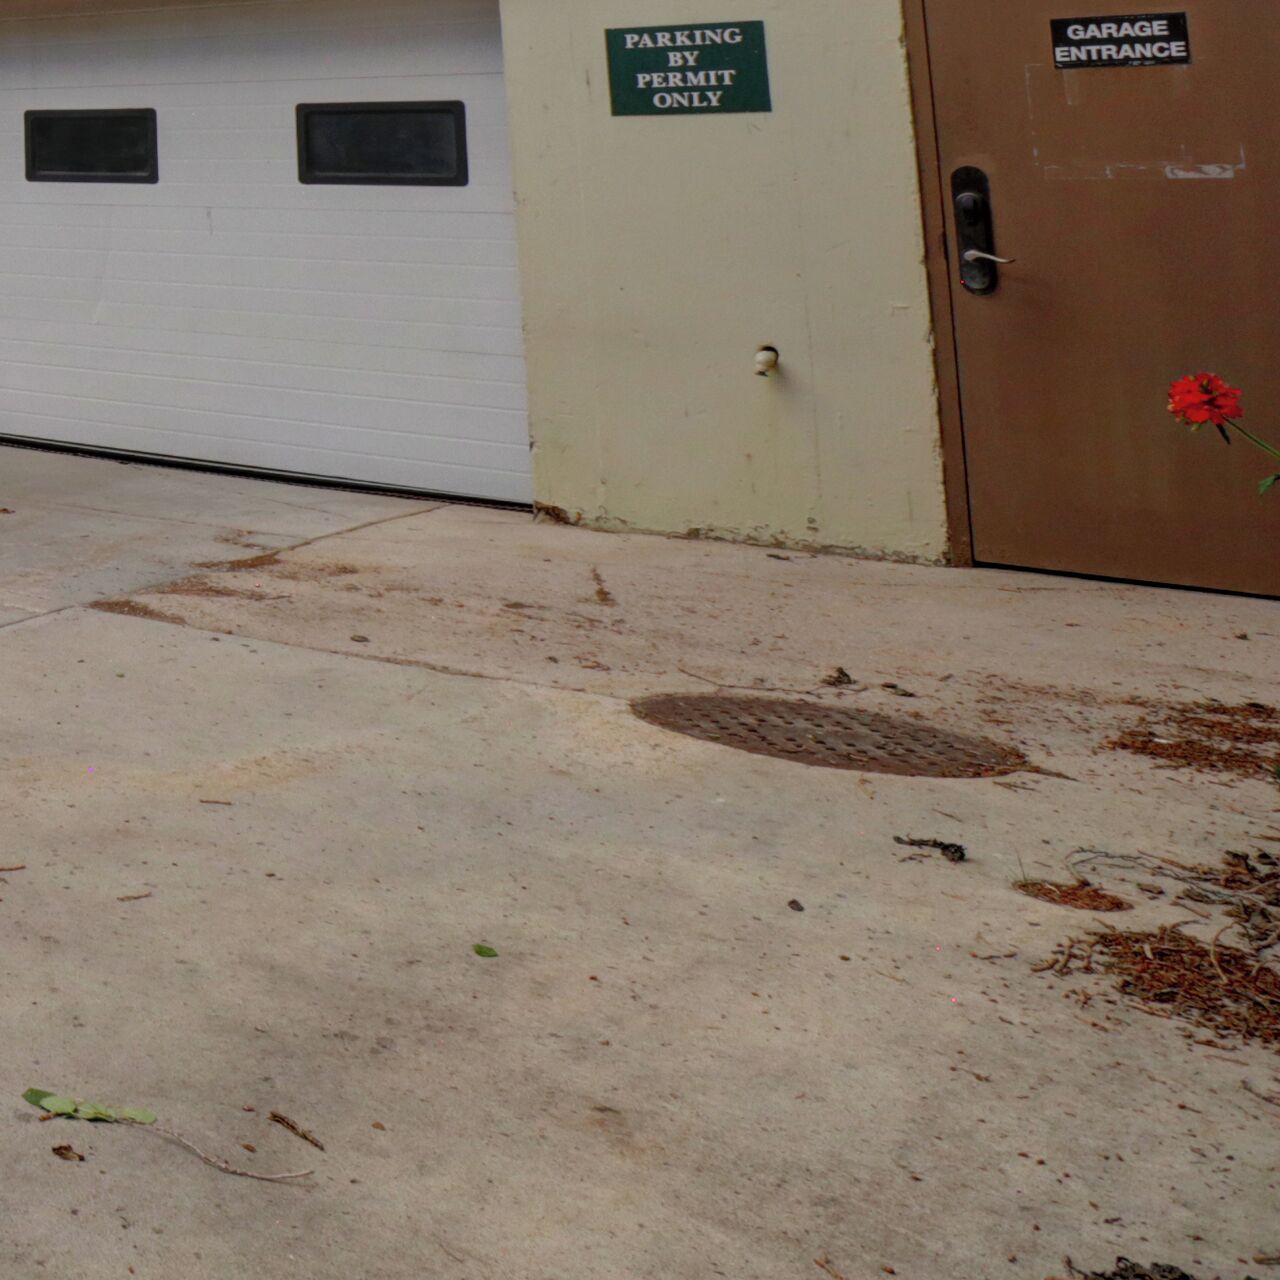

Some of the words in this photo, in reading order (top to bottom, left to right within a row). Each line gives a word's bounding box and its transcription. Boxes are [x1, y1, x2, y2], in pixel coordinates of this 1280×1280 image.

[624, 28, 743, 49] PARKING
[1067, 20, 1170, 40] GARAGE
[667, 51, 700, 67] BY
[1054, 41, 1188, 62] ENTRANCE
[636, 70, 736, 89] PERMIT
[652, 91, 723, 109] ONLY
